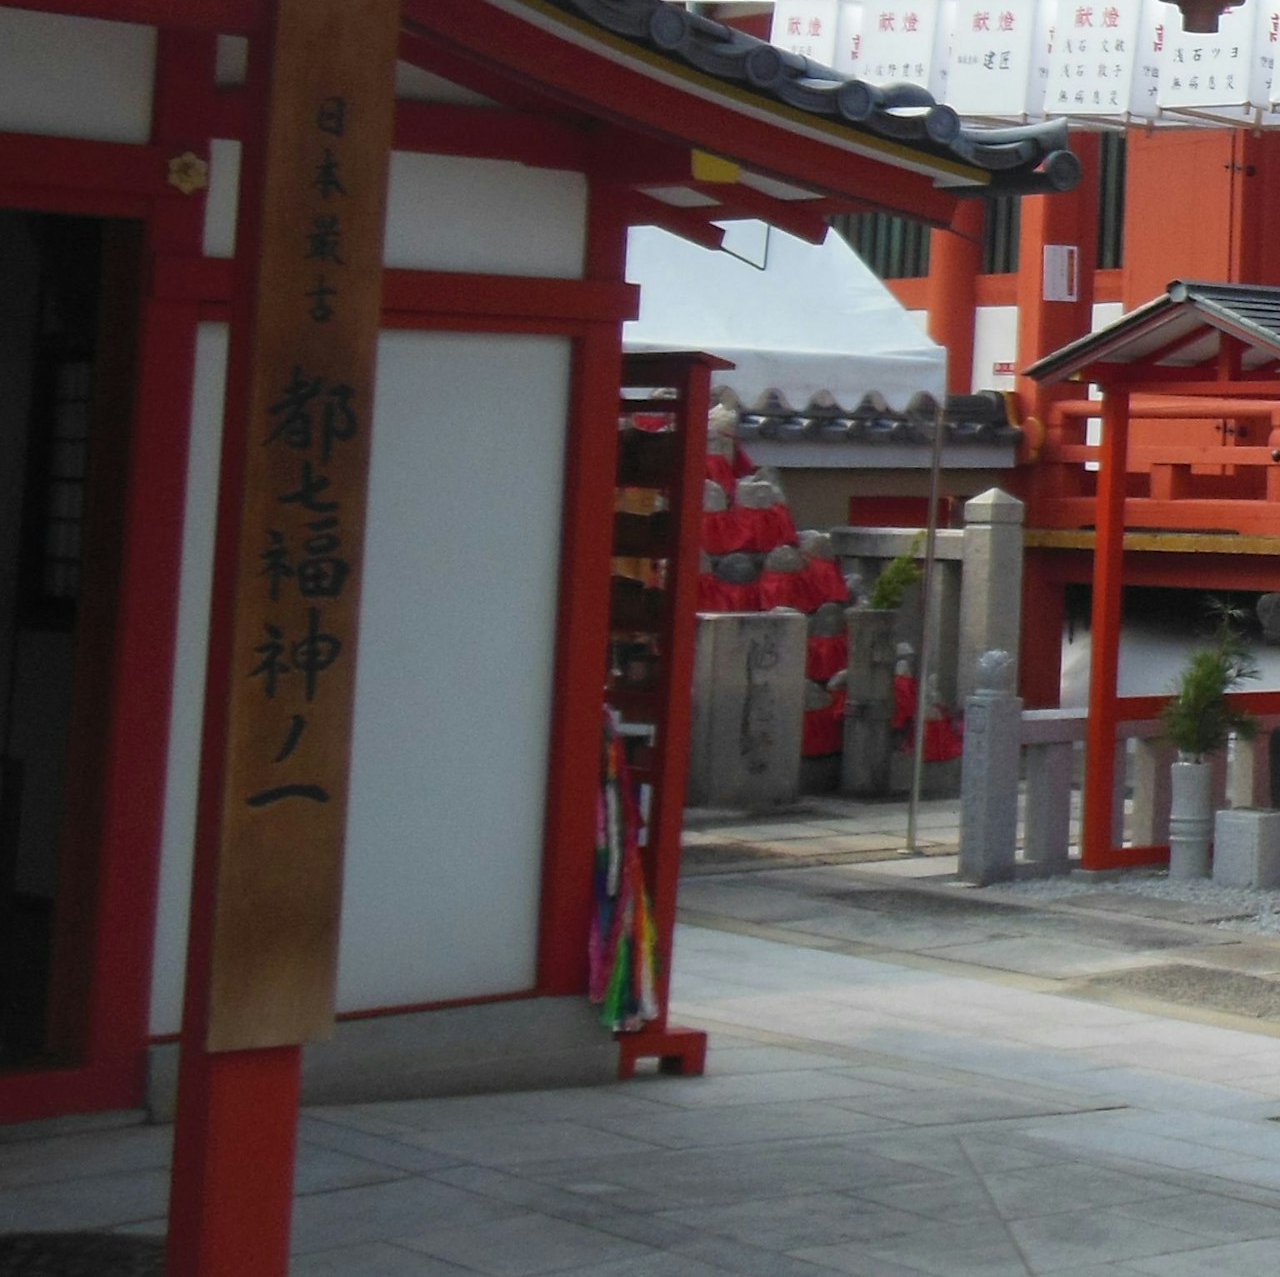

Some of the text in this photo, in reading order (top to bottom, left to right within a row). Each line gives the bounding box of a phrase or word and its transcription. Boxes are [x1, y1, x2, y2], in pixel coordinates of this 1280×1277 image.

[787, 16, 822, 37] 献燈
[878, 11, 920, 33] 献燈
[972, 10, 1016, 32] 献燈
[1074, 6, 1120, 28] 献燈
